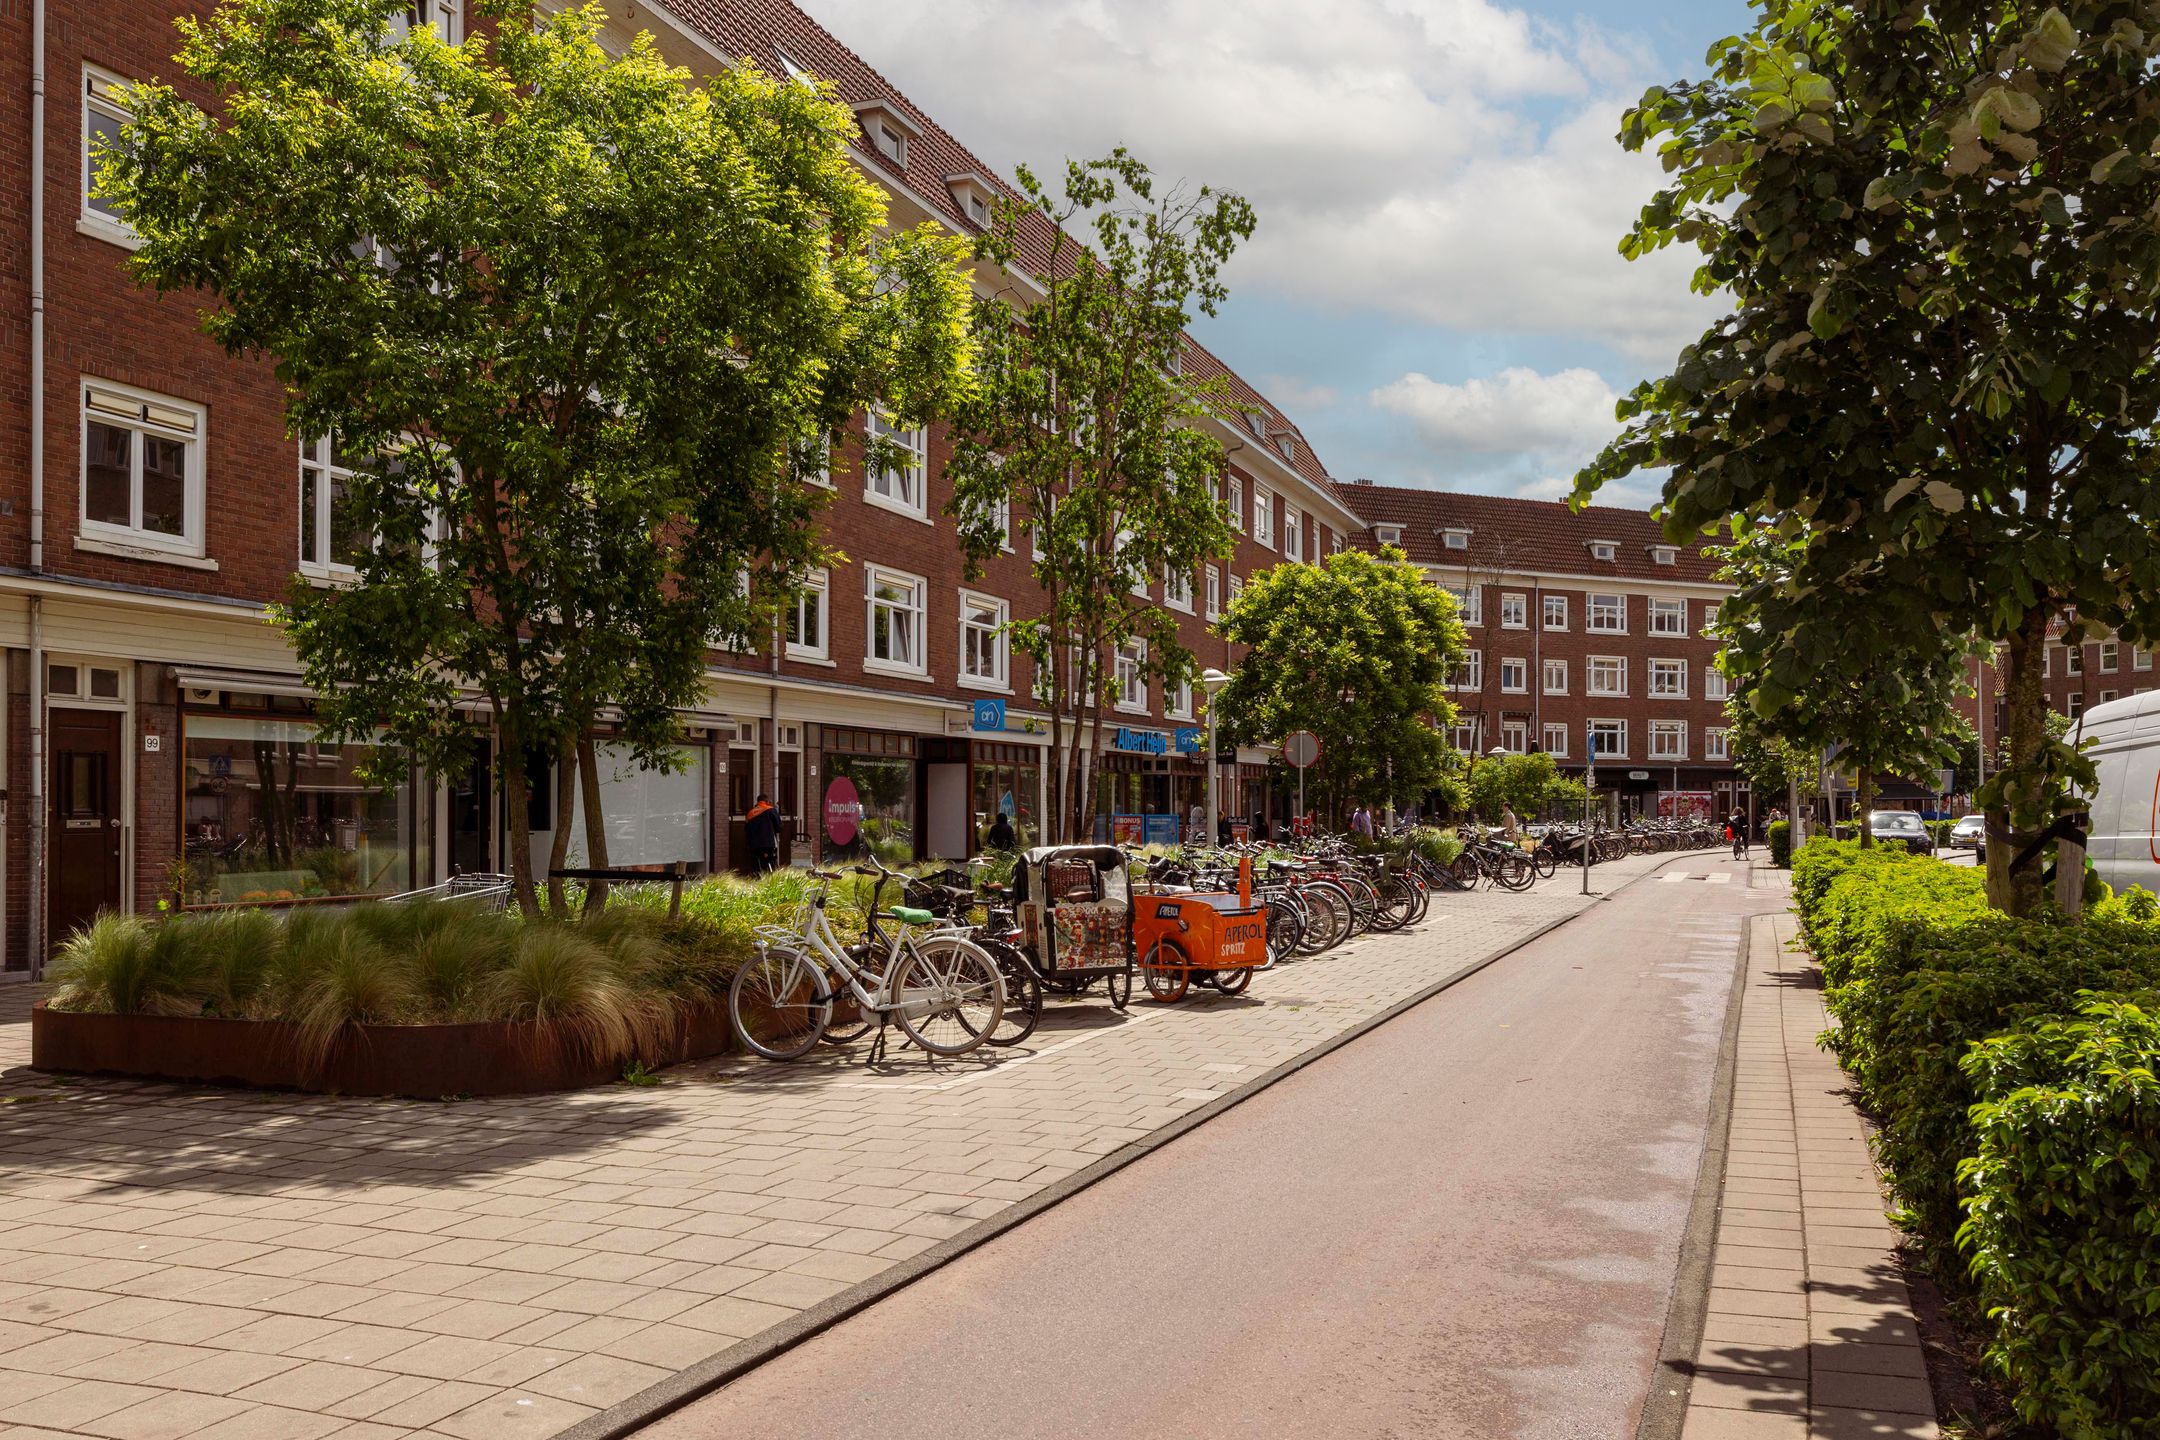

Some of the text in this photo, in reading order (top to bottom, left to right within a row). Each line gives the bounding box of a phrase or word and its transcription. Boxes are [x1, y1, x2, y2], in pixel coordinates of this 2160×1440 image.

[147, 738, 158, 748] 99
[1117, 728, 1167, 757] Albert Heijn
[1160, 905, 1179, 917] APEROL
[1225, 924, 1262, 943] APEROL
[1221, 942, 1246, 957] SPRITZ
